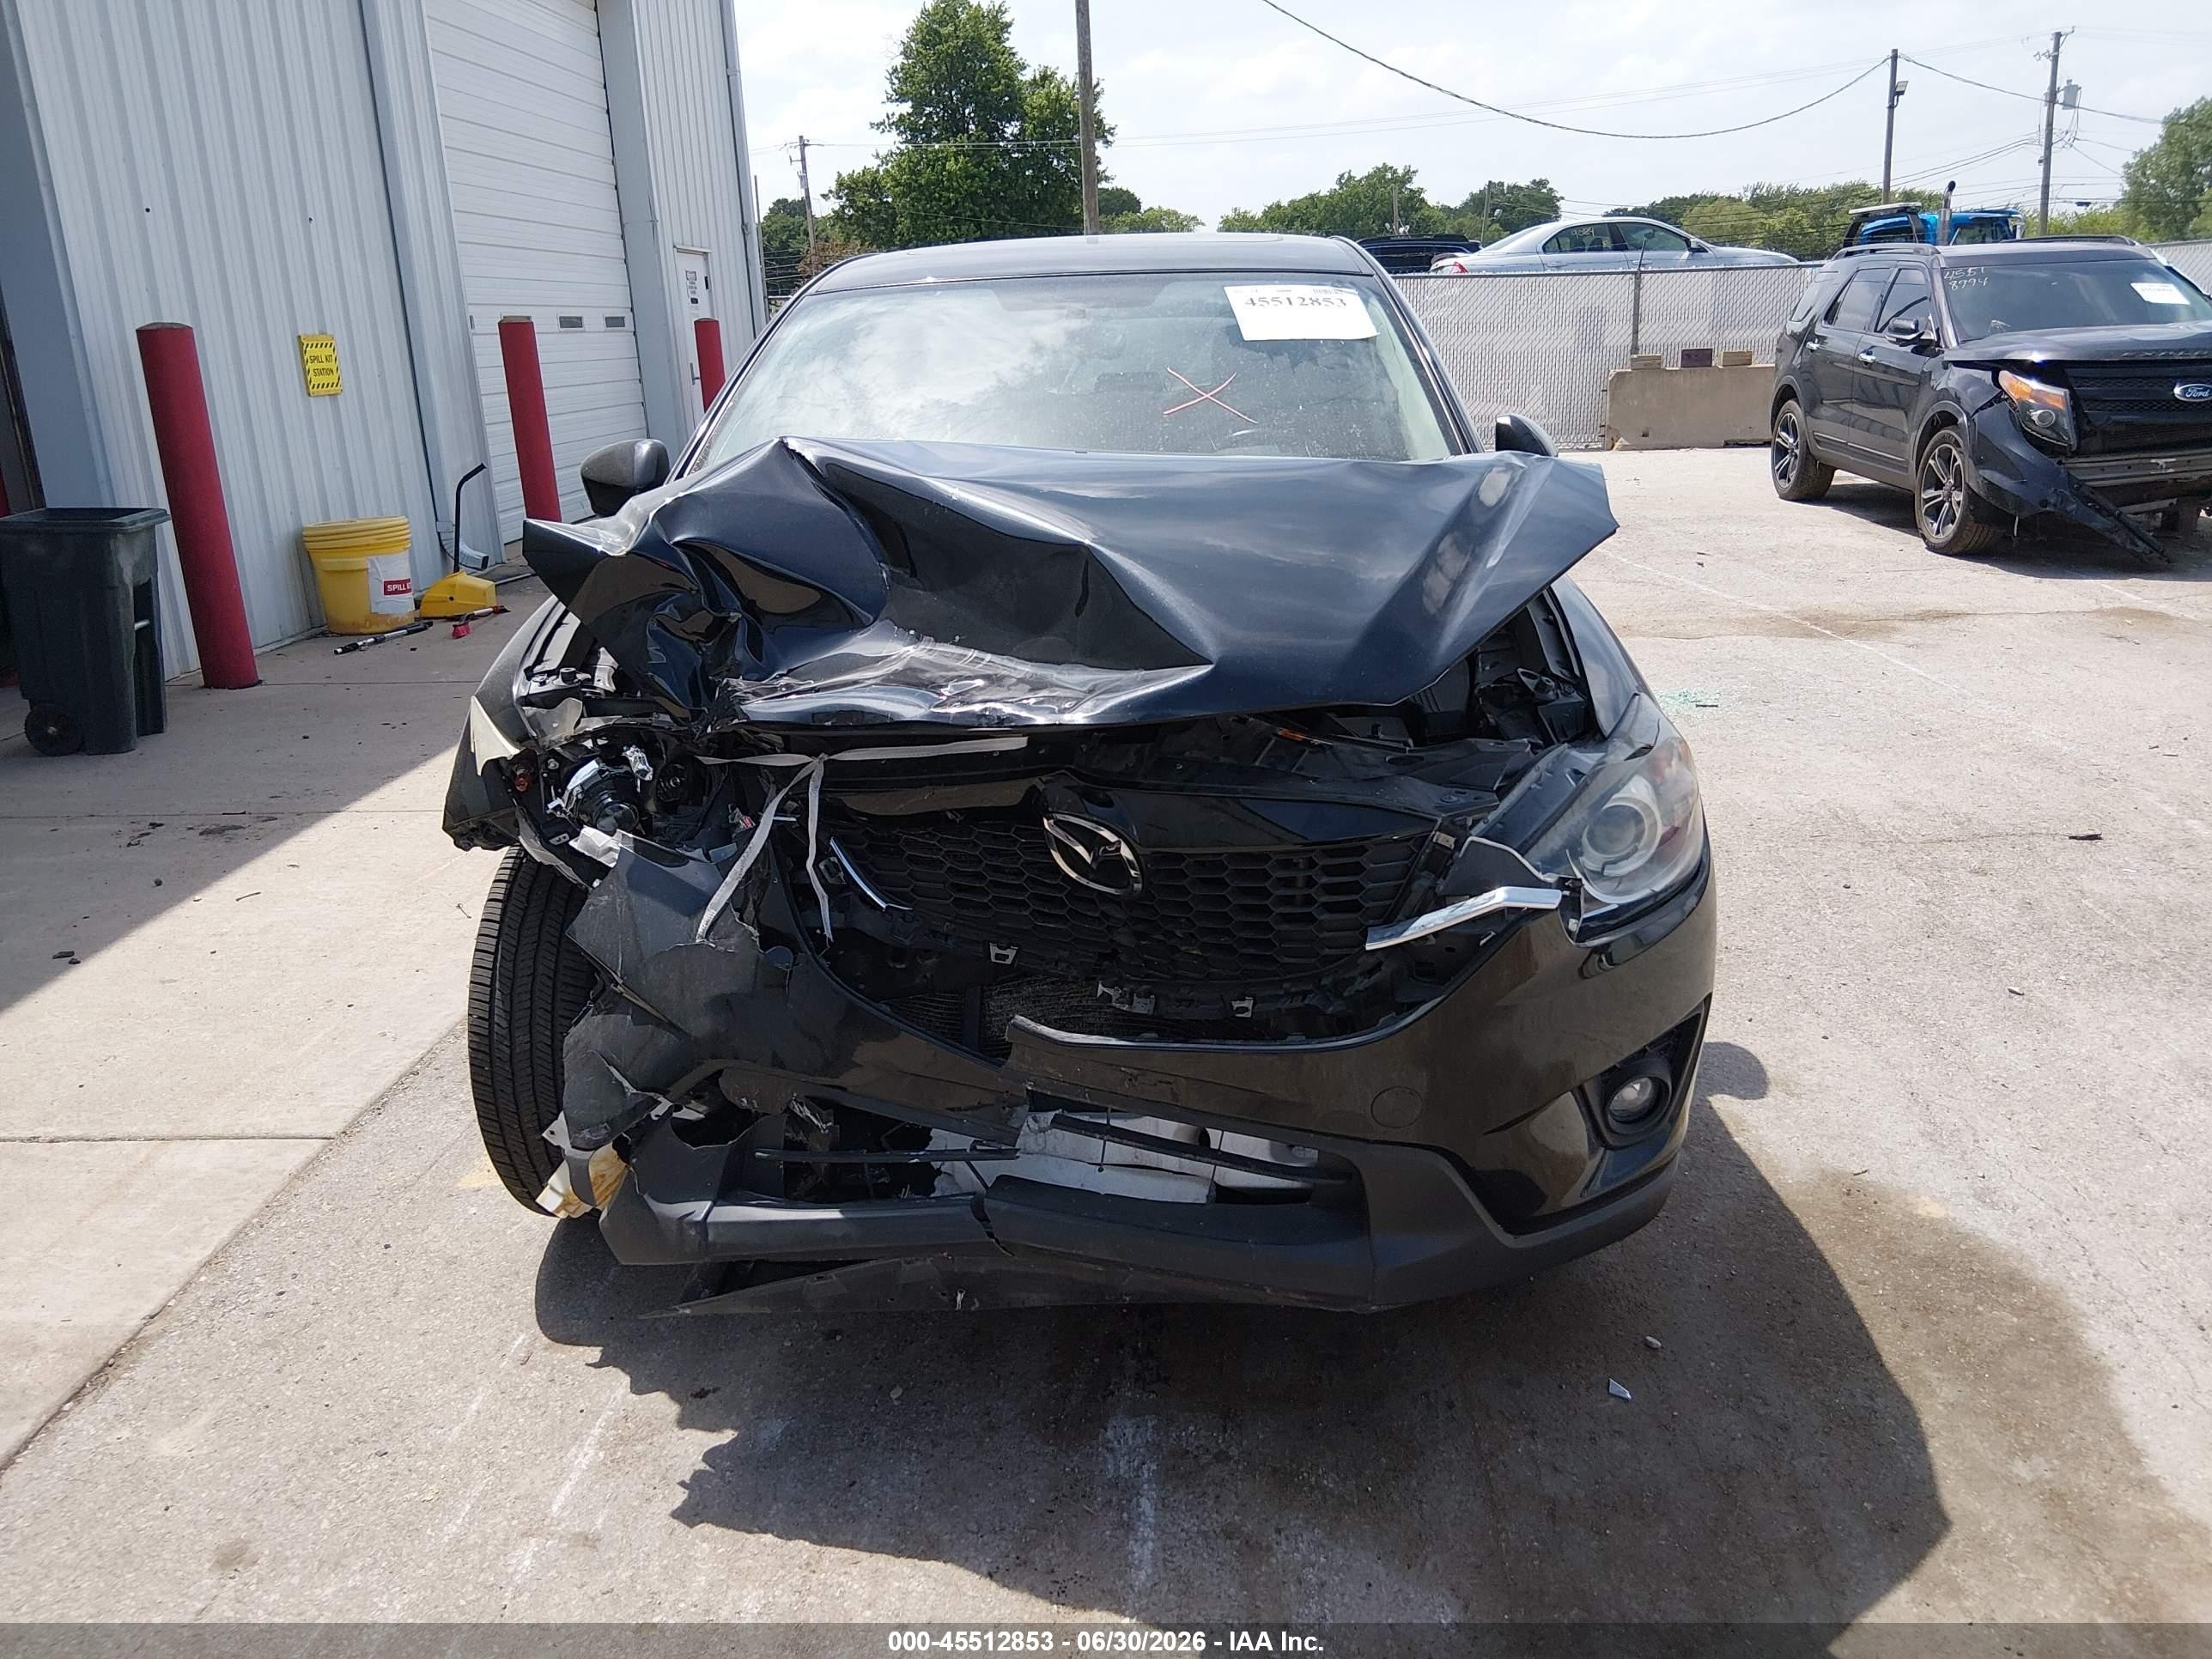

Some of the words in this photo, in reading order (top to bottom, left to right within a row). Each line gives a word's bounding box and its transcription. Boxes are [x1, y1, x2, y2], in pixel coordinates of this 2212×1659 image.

[1244, 296, 1346, 307] 45512853
[309, 355, 324, 363] SPILL
[313, 368, 334, 377] STATION
[2185, 386, 2210, 398] Ford
[387, 583, 406, 592] SPILL
